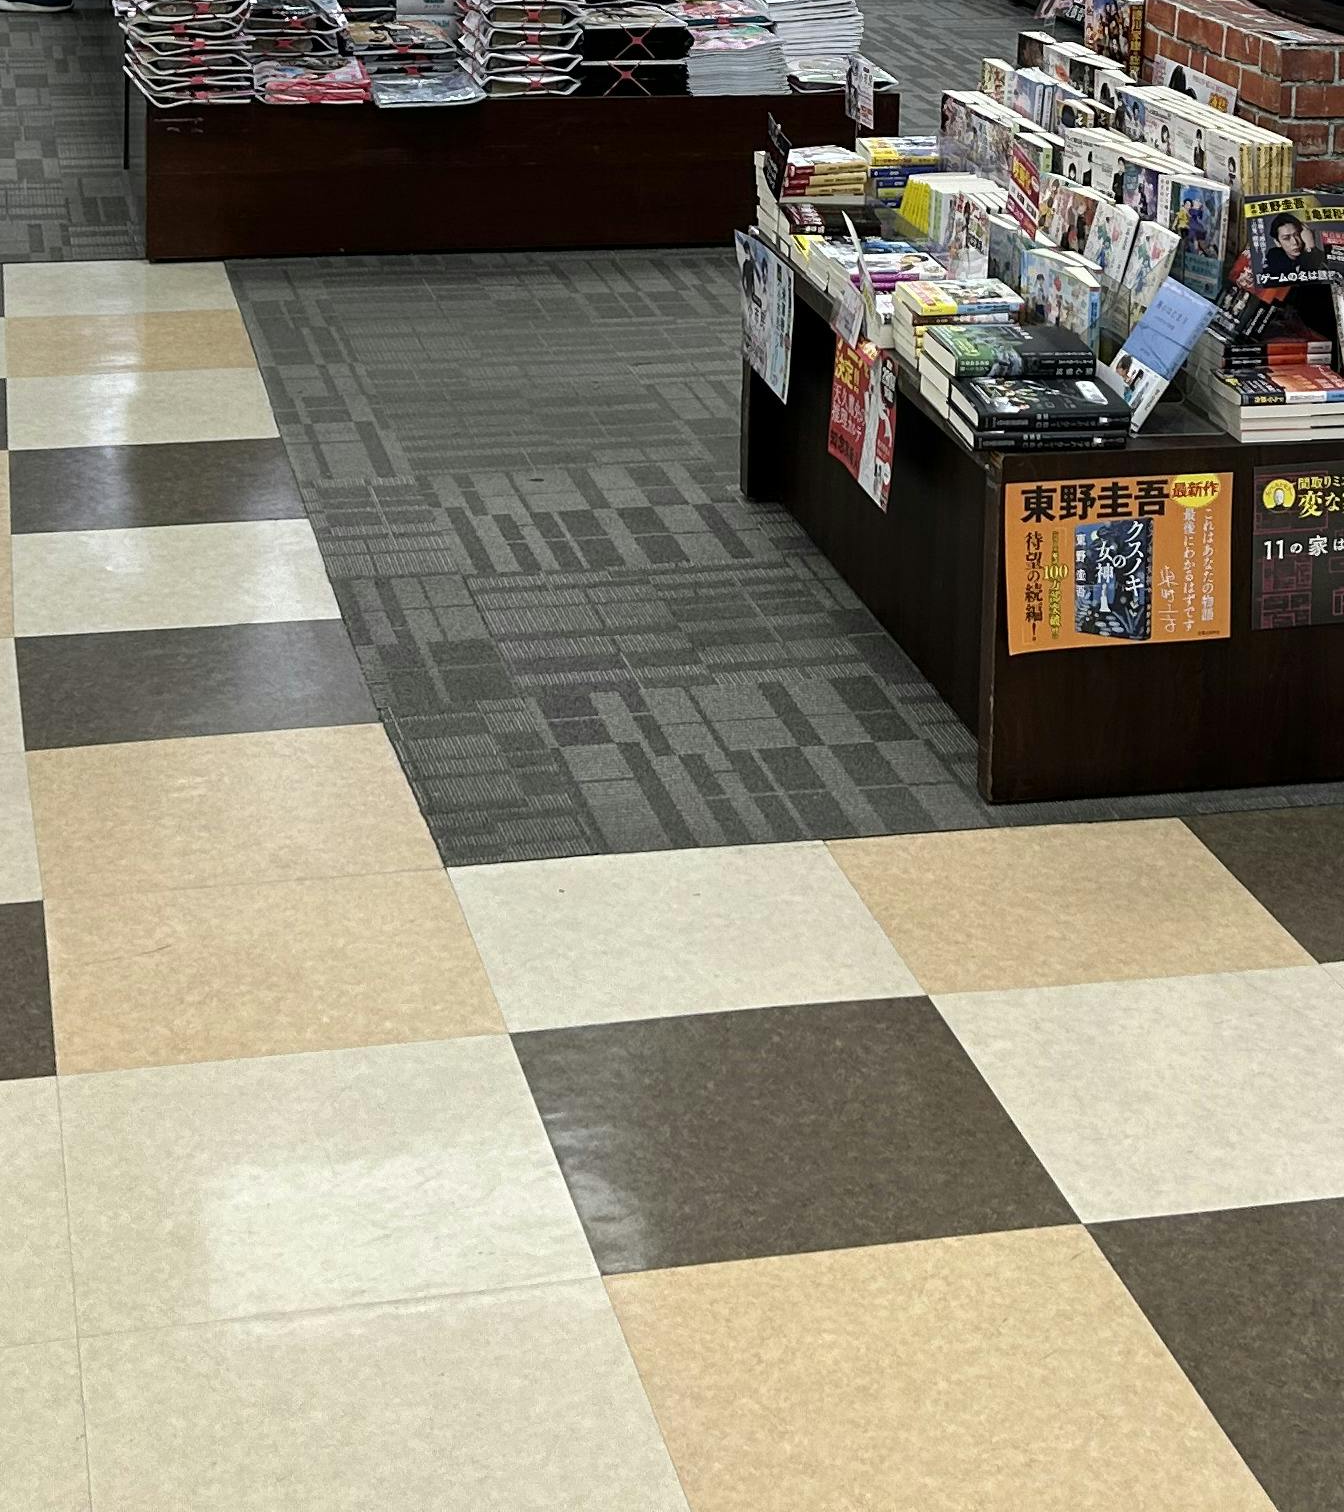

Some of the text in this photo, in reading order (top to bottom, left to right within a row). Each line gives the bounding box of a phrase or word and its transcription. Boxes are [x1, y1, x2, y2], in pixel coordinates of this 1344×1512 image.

[1258, 198, 1305, 215] 東野圭吾
[1020, 479, 1170, 524] 東野圭吾
[1171, 480, 1221, 498] 最新作
[1124, 520, 1145, 598] クスノキ
[1024, 530, 1044, 642] 待望の続編!
